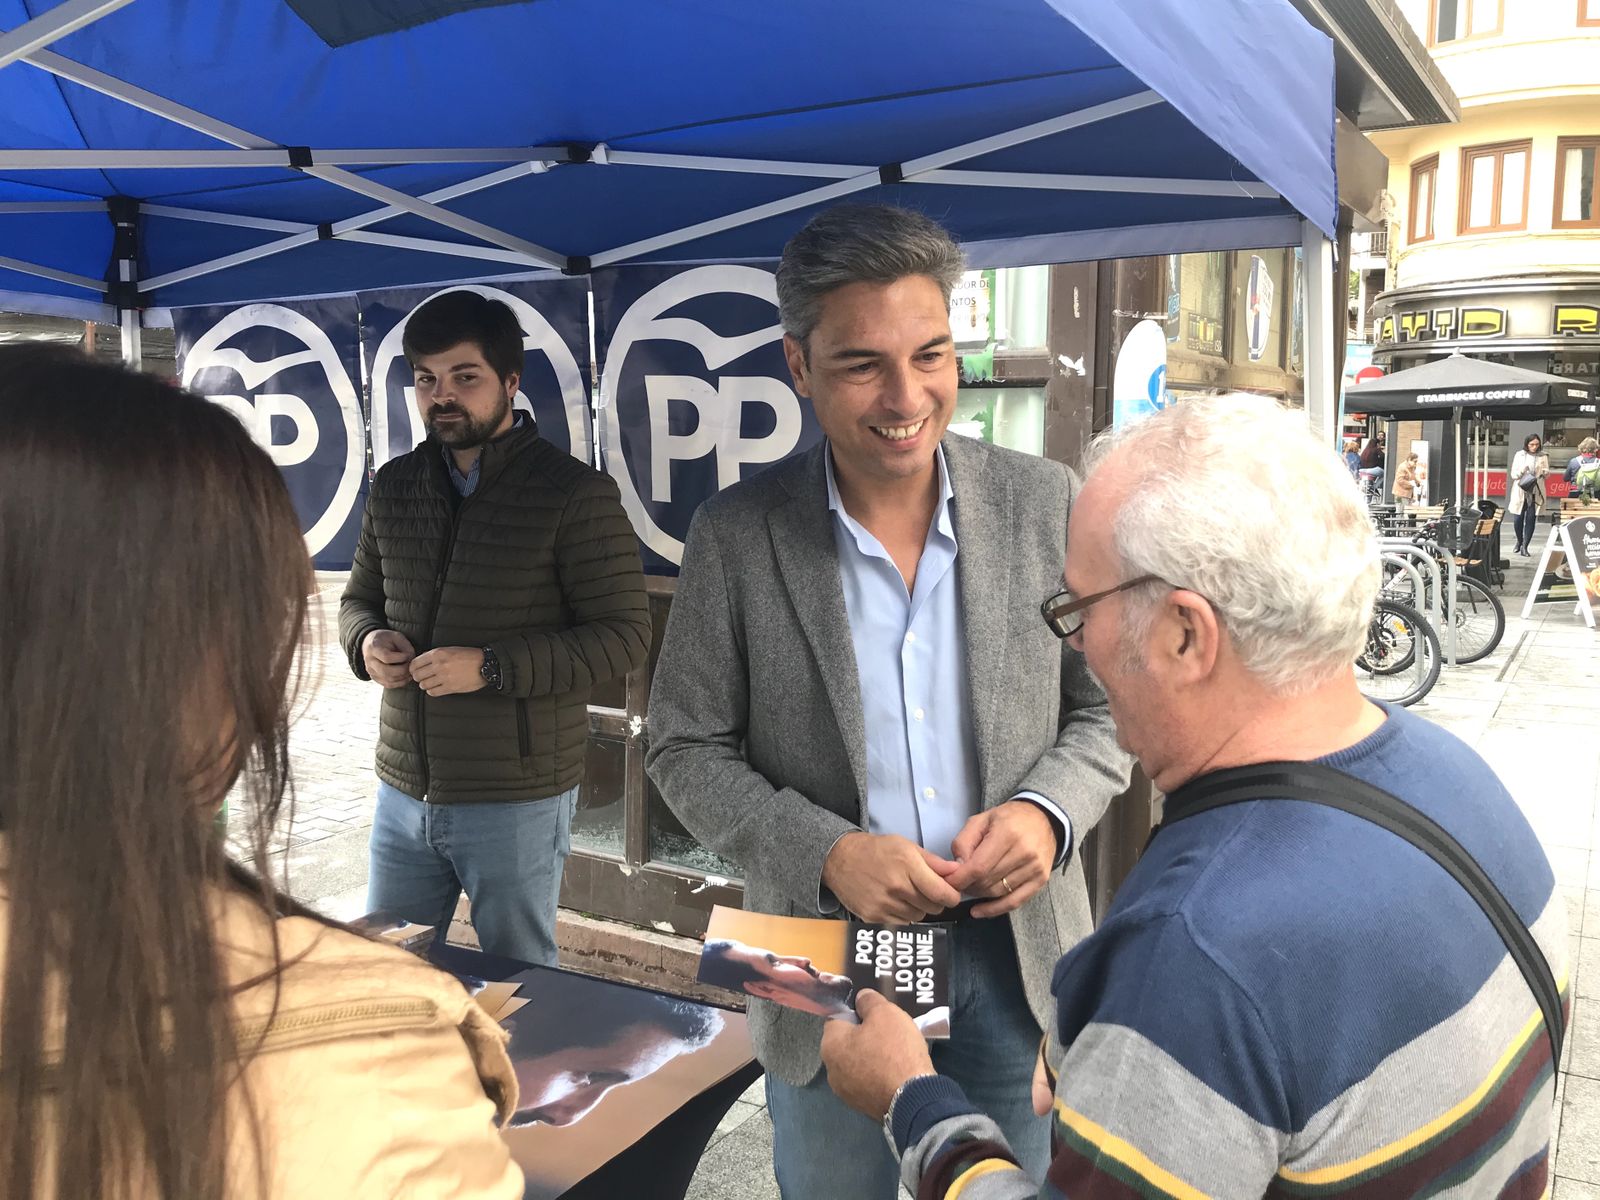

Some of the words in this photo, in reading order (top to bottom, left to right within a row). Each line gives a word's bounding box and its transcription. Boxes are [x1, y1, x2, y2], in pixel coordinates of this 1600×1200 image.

[951, 297, 976, 306] NTOS
[1375, 307, 1507, 344] AVID
[1416, 390, 1484, 403] STARBUCKS
[1485, 389, 1531, 400] COFFEE
[1579, 404, 1597, 413] FEE
[644, 374, 802, 503] PP
[855, 929, 873, 965] POR
[875, 930, 894, 978] TODO
[896, 931, 914, 968] QUE
[916, 929, 934, 966] UNE.
[895, 969, 914, 992] LO
[916, 967, 934, 1004] NOS
